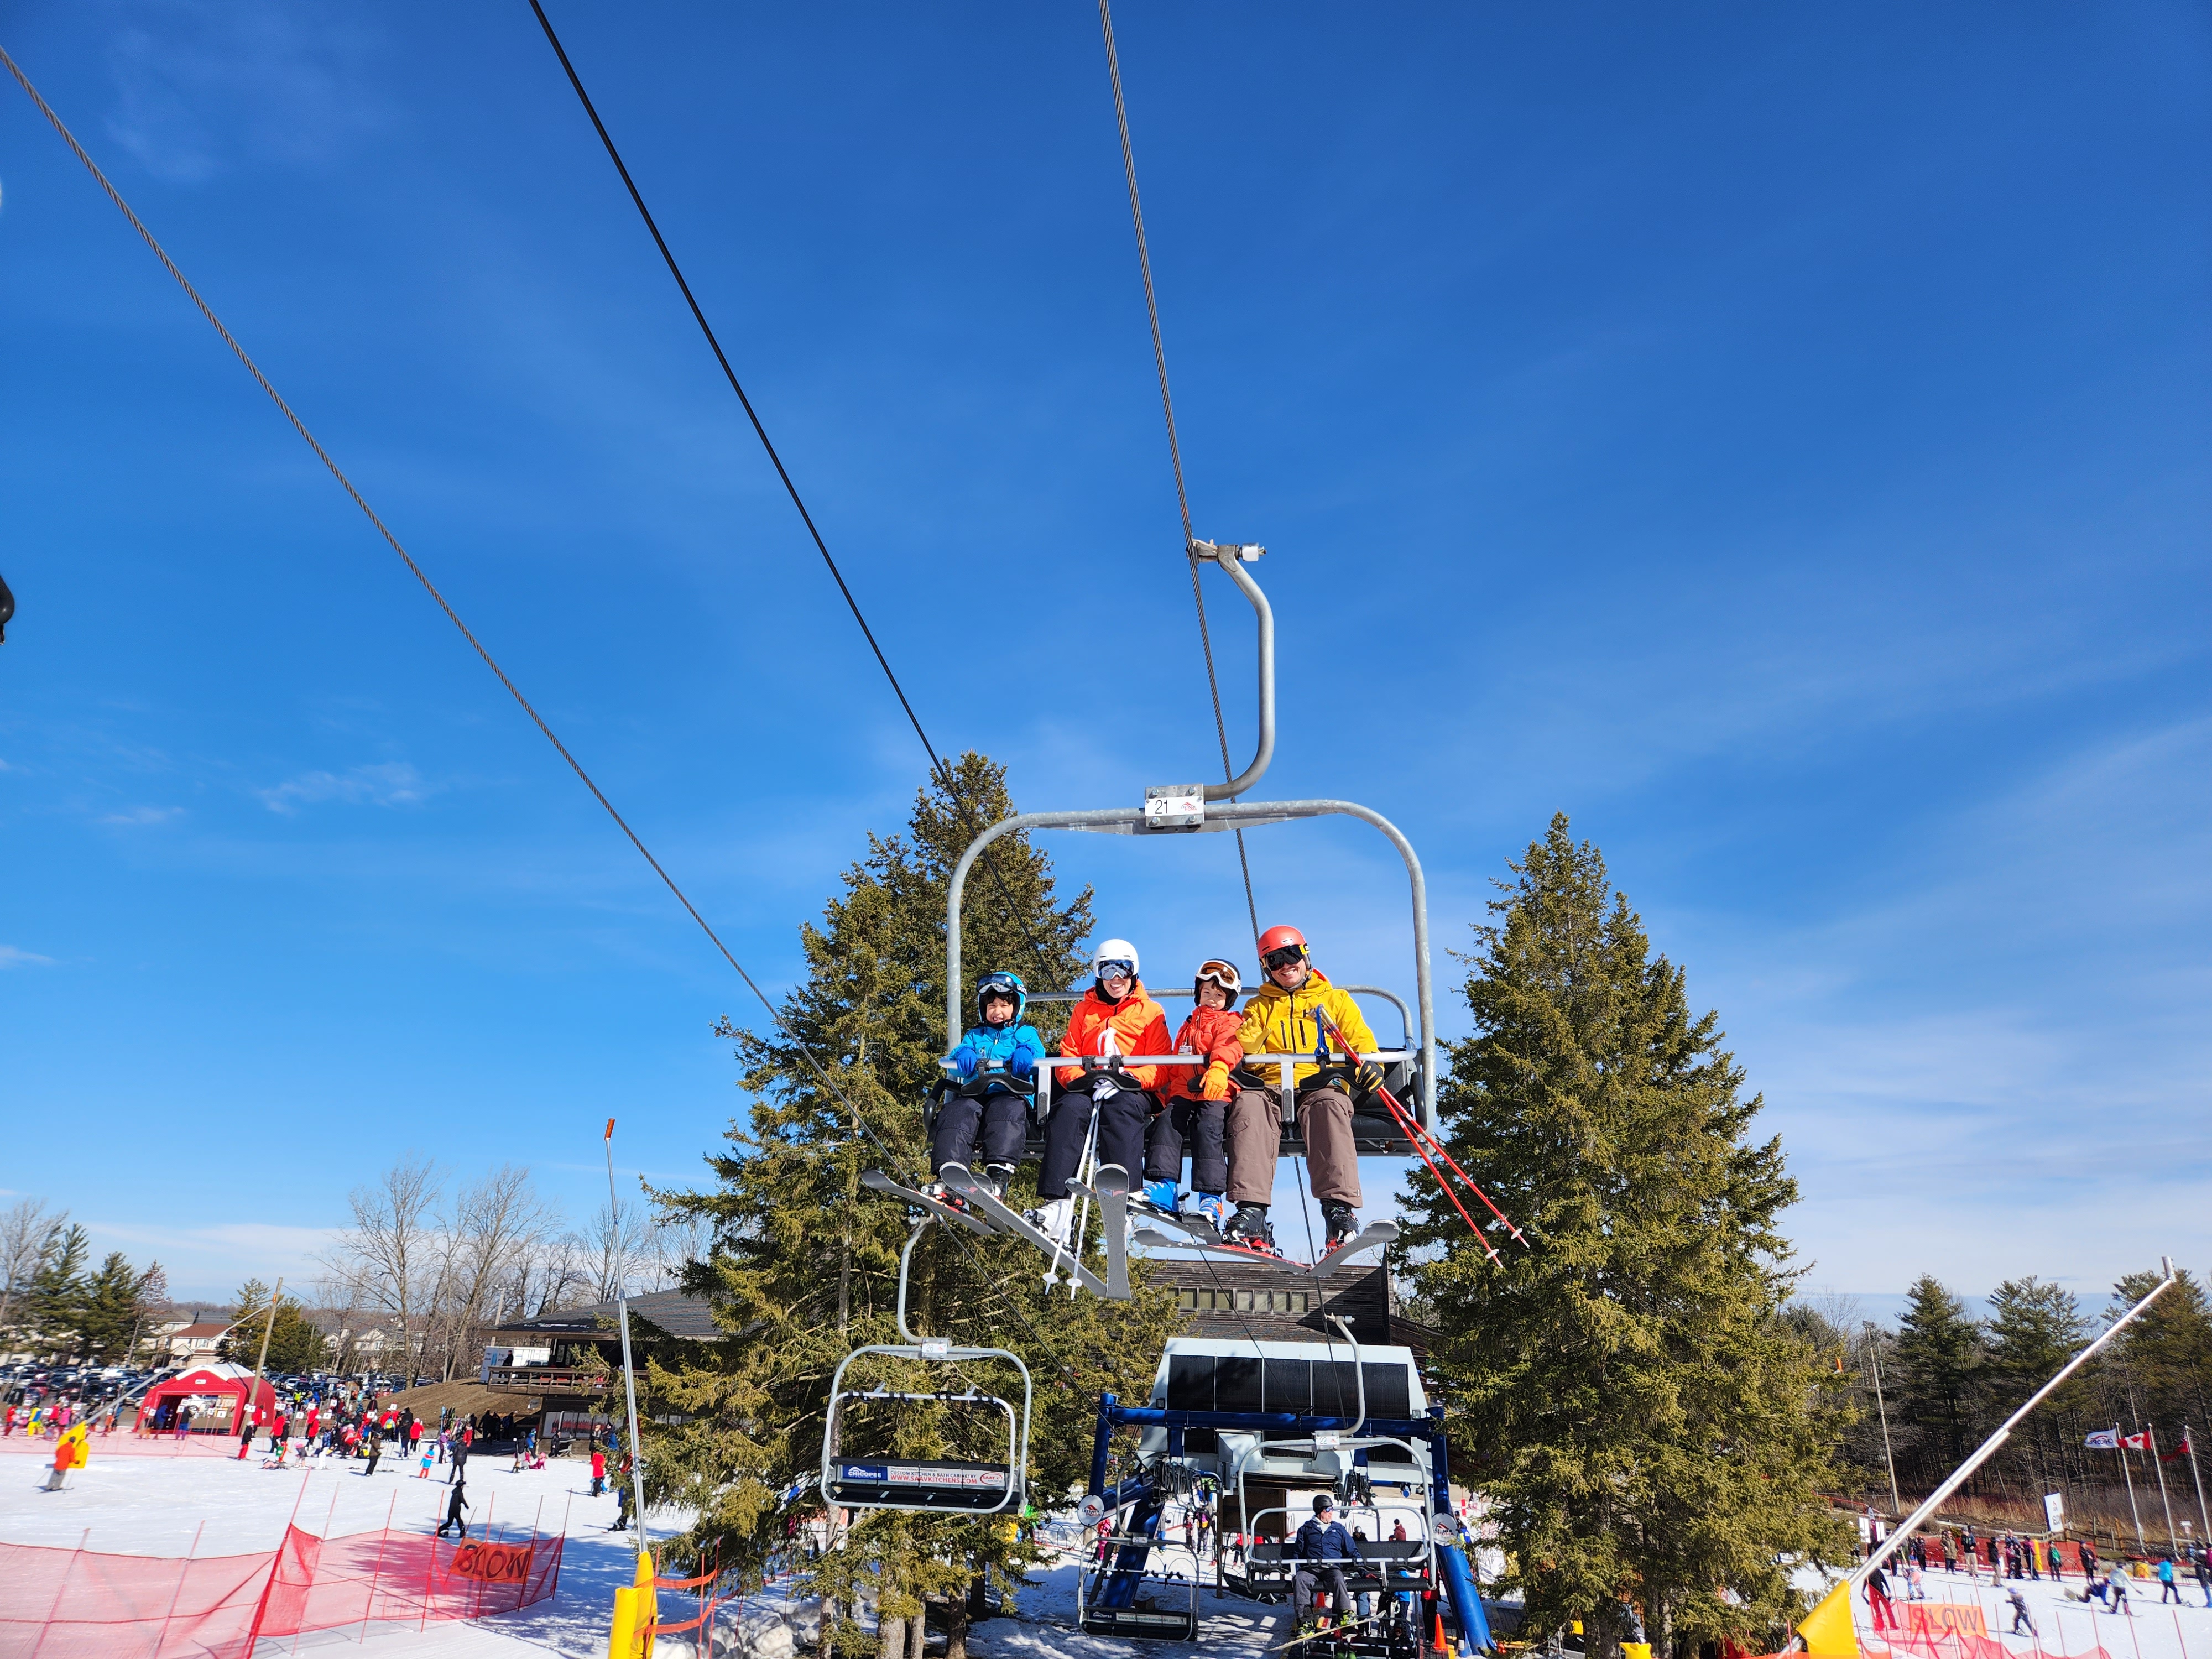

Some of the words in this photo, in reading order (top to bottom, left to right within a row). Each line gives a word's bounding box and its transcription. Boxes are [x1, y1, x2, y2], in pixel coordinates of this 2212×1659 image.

[1155, 799, 1168, 814] 21
[457, 1543, 531, 1578] SLOW
[1912, 1606, 1978, 1631] SLOW
